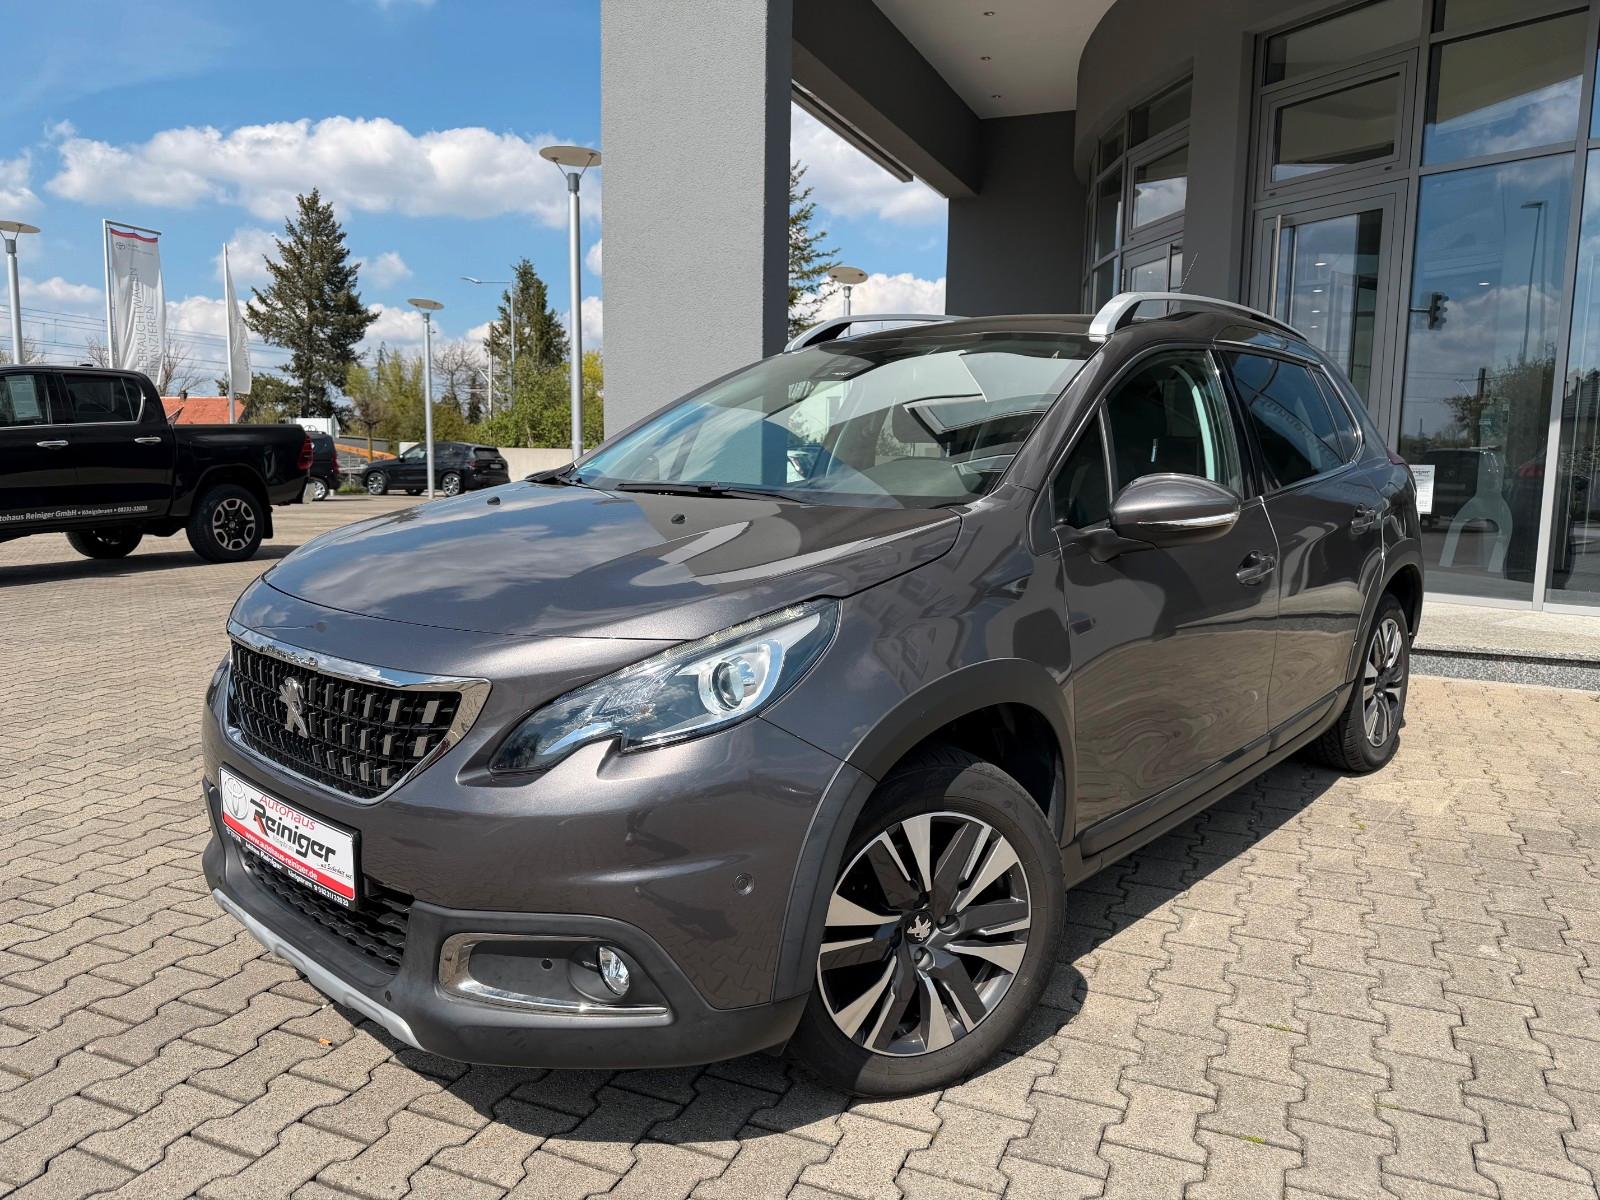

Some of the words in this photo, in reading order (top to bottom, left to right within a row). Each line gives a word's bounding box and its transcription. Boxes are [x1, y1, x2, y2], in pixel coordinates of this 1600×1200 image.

[25, 511, 54, 520] Reiniger
[55, 509, 77, 518] GmbH
[250, 798, 336, 863] Reiniger
[260, 795, 316, 831] Autohaus
